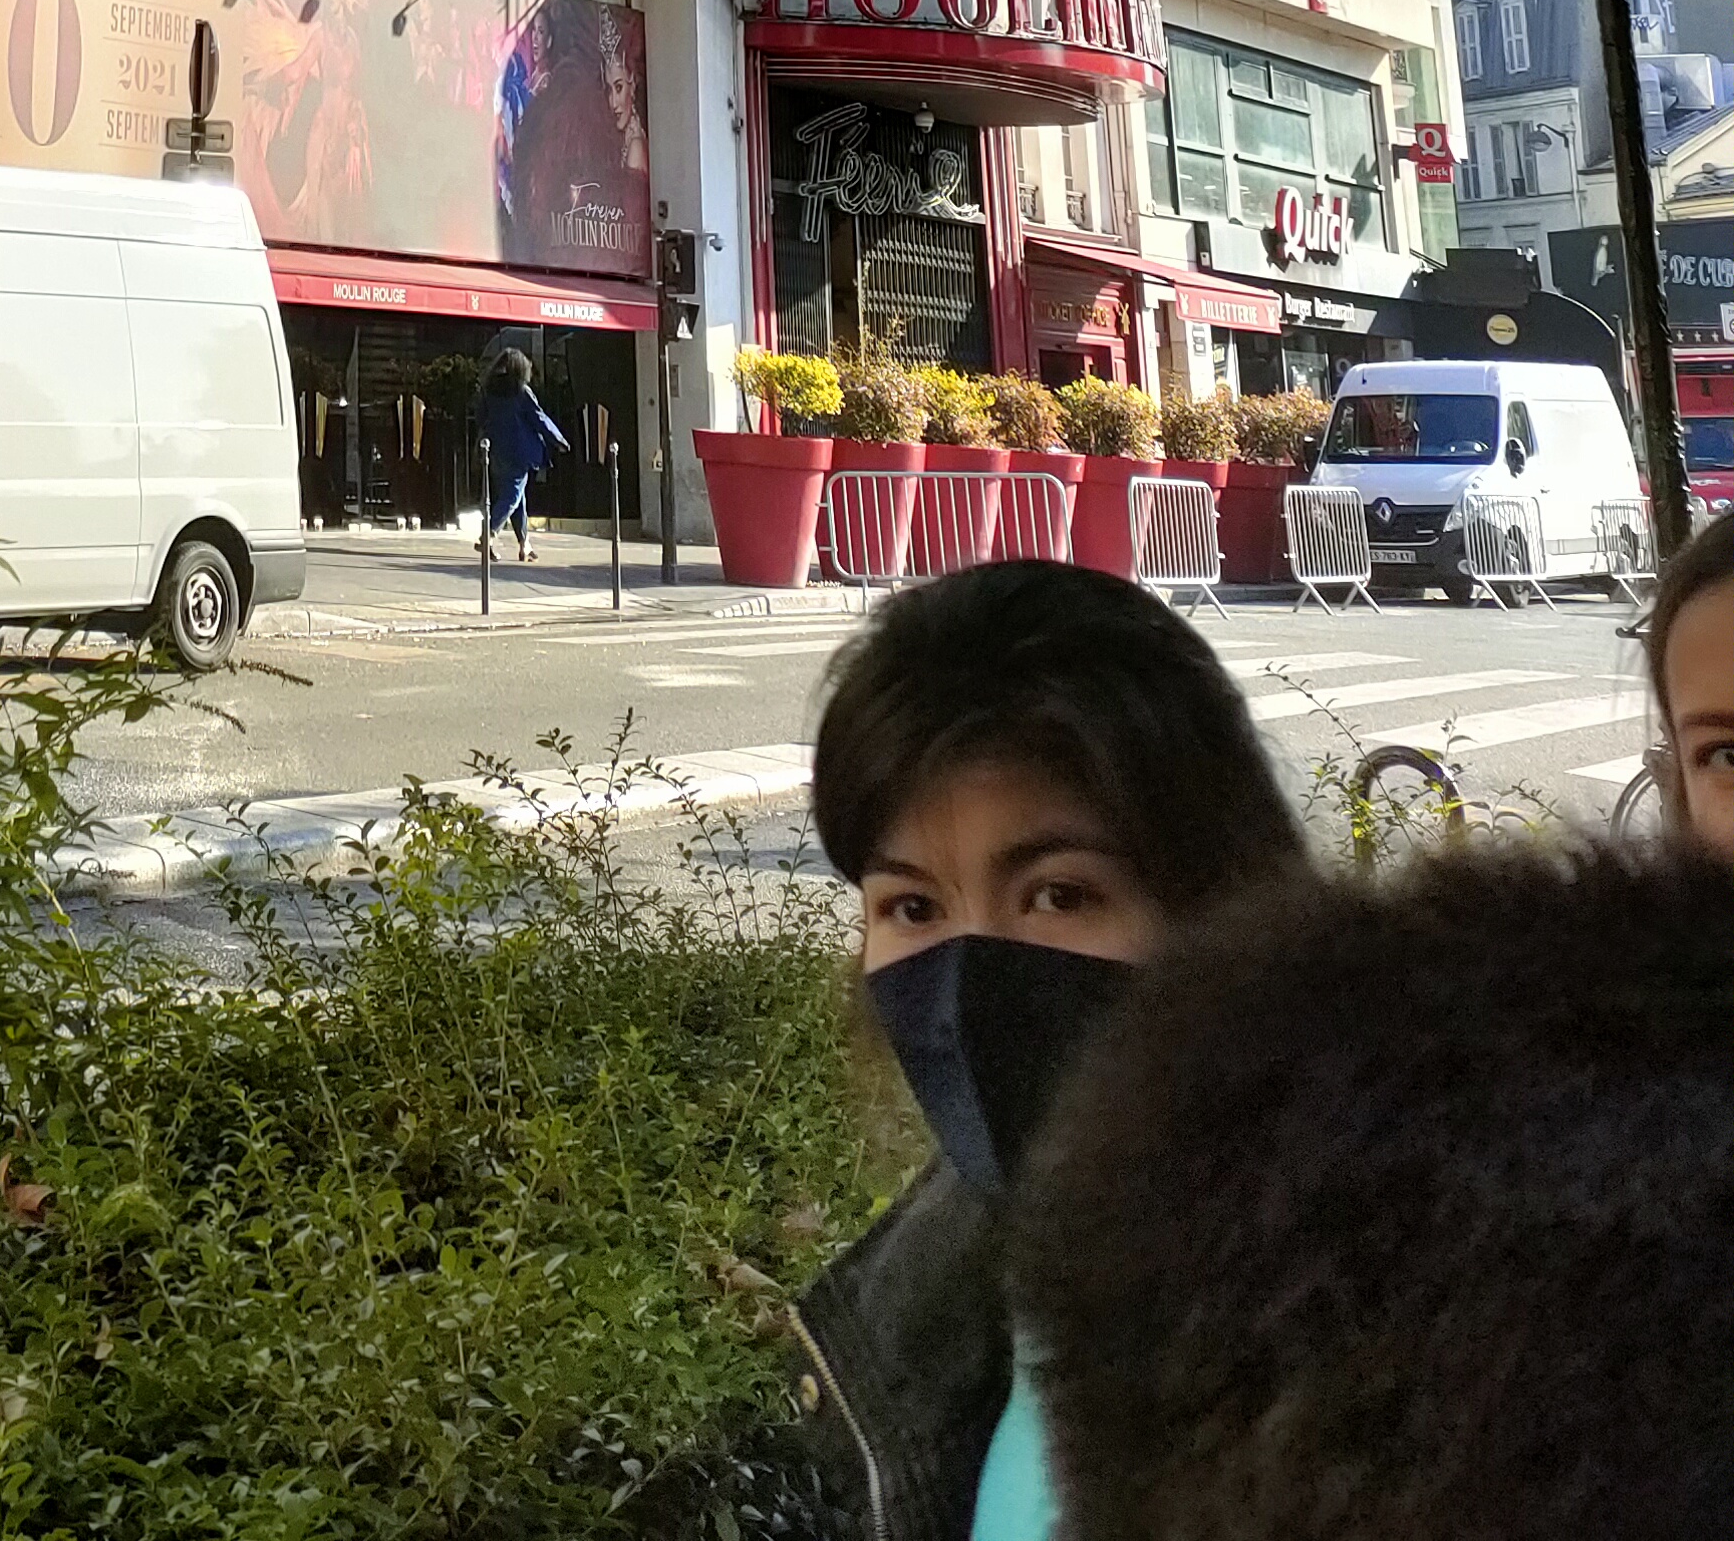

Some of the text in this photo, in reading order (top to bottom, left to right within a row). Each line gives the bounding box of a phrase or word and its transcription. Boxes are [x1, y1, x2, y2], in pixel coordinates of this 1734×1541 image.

[110, 3, 190, 44] SEPTEMBRE
[117, 53, 177, 97] 2021
[106, 109, 166, 145] SEPTEM
[1417, 128, 1446, 157] Q
[1419, 167, 1448, 178] Quick
[564, 182, 625, 223] Forever
[550, 211, 641, 255] MOULIN ROUGE
[1279, 186, 1355, 264] Quick
[333, 283, 406, 305] MOULIN ROUGE
[1284, 290, 1312, 321] Burger
[540, 300, 604, 322] MOULIN ROUGE
[1200, 298, 1258, 325] BILLETTERIE
